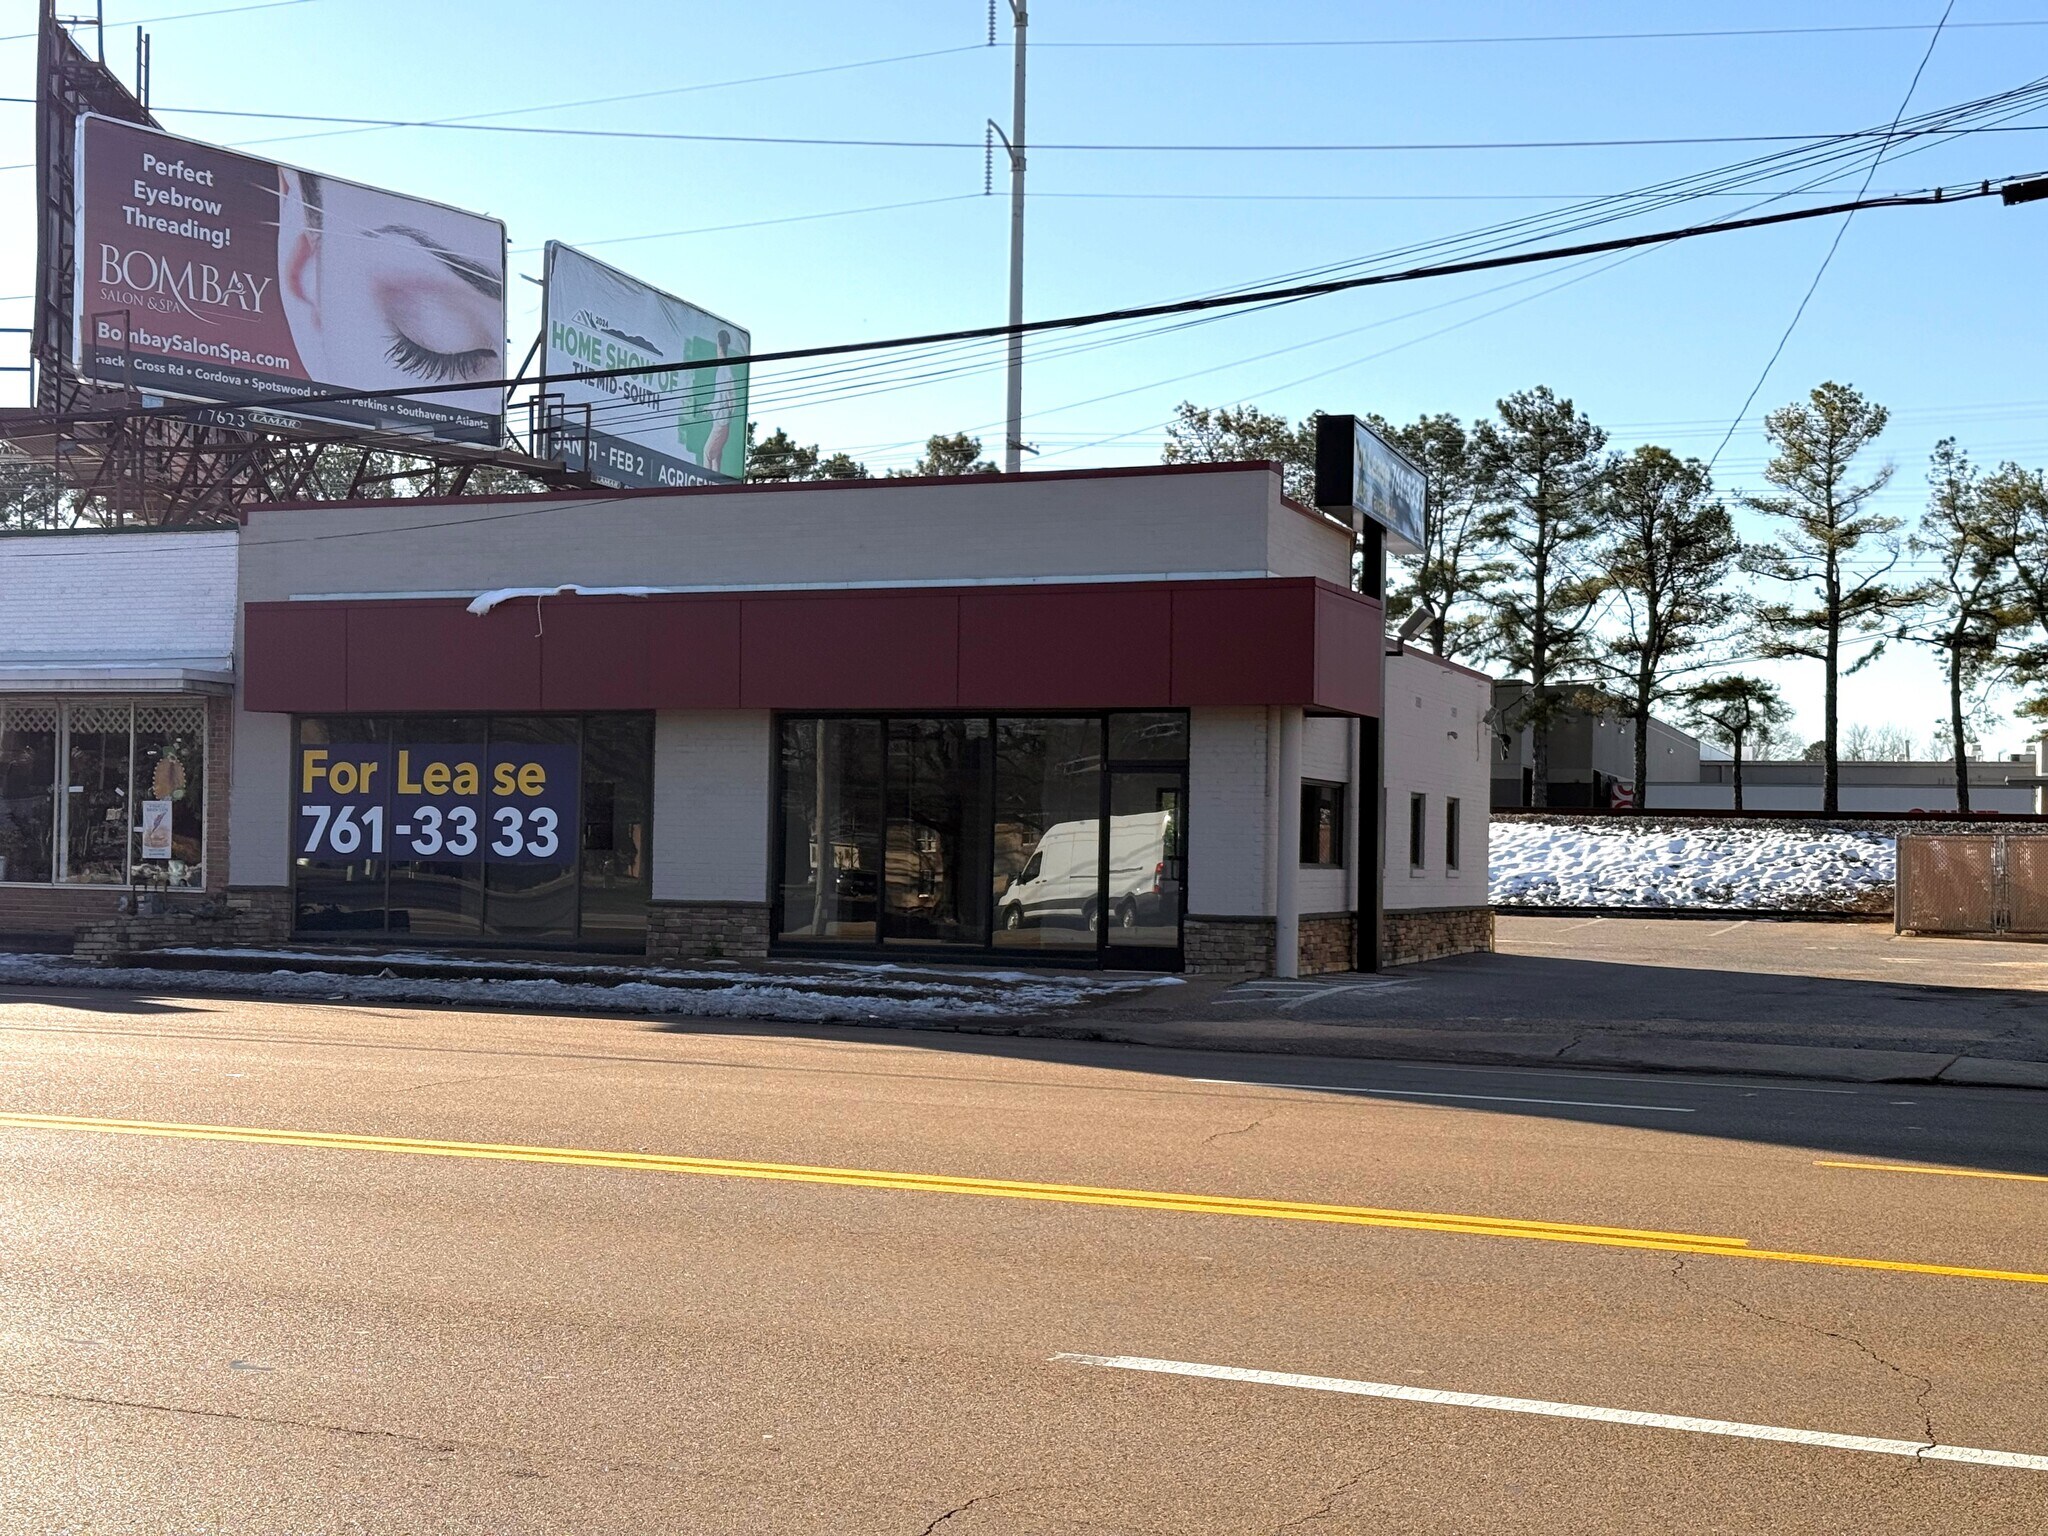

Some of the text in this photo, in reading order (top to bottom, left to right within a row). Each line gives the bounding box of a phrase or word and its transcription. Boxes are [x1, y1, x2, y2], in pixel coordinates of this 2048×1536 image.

[143, 153, 214, 187] Perfect
[134, 180, 222, 216] Eyebrow
[122, 205, 231, 249] Threading!
[98, 243, 273, 319] BOMBAY
[100, 288, 144, 306] SALON
[159, 300, 181, 313] SPA
[595, 316, 609, 328] 2024
[98, 321, 290, 370] BombaySalonSpa.com
[552, 320, 602, 366] HOME
[606, 342, 656, 387] SHOW
[134, 358, 166, 373] Cross
[168, 363, 184, 376] Rd
[195, 368, 242, 385] Cordova
[252, 377, 311, 397] Spotswood
[397, 404, 447, 422] Southaven
[252, 412, 297, 429] LAMAR
[553, 431, 582, 457] JAN
[609, 447, 634, 473] FEB
[636, 456, 645, 477] 2
[302, 750, 546, 797] For Lease
